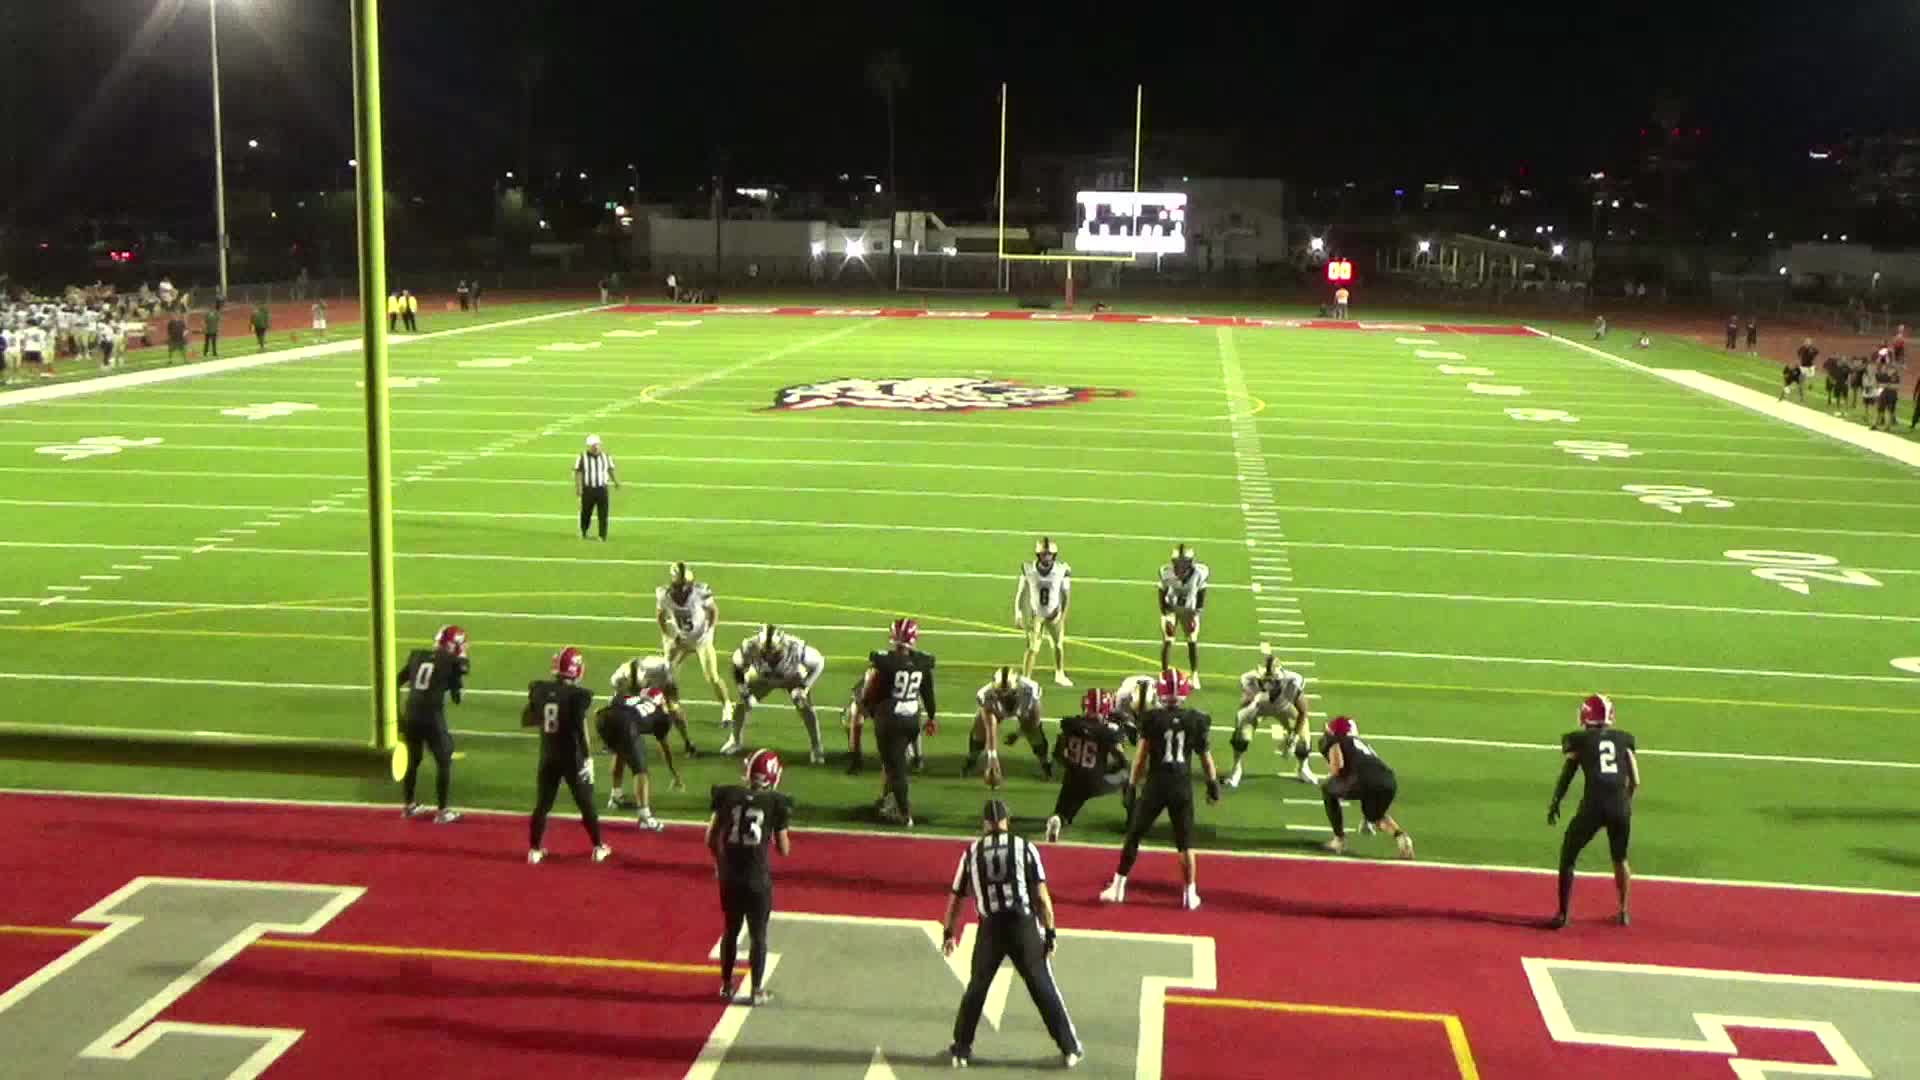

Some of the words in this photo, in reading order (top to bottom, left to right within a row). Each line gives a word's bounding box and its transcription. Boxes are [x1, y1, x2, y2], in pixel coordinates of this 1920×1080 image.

[1622, 484, 1734, 514] 30
[1723, 549, 1883, 595] 20
[414, 662, 434, 690] 0
[893, 670, 923, 699] 92
[543, 702, 560, 734] 8
[1064, 736, 1098, 769] 96
[1161, 729, 1186, 763] 11
[1598, 740, 1618, 774] 2
[728, 804, 765, 845] 13
